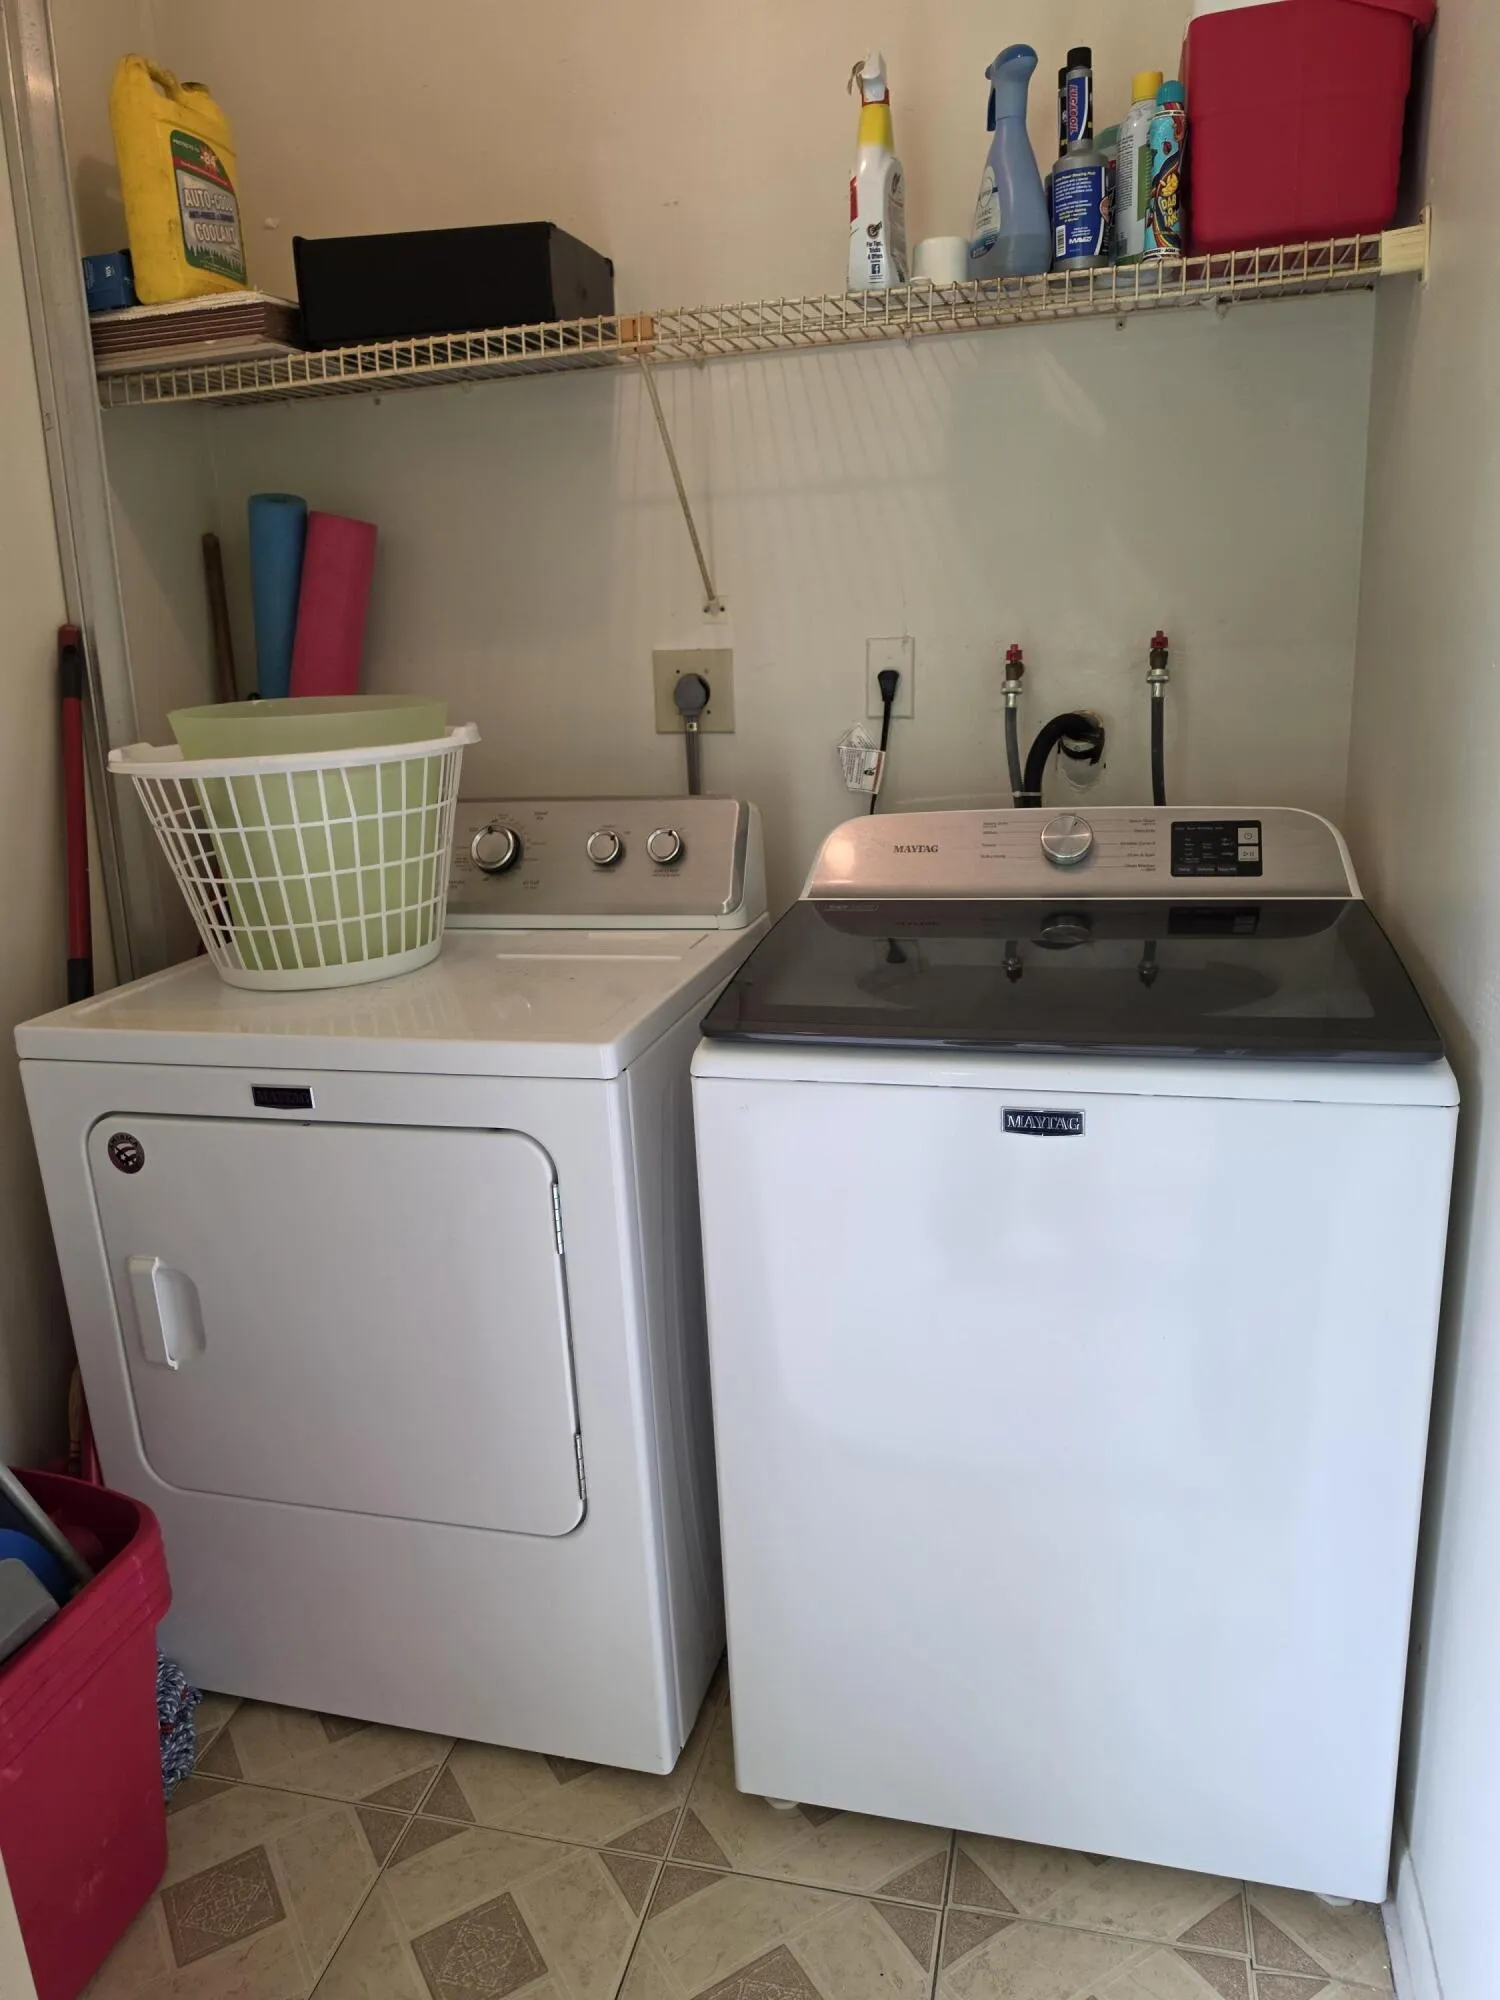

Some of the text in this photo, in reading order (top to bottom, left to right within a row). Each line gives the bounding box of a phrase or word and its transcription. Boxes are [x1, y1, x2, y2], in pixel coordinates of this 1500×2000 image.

[195, 223, 235, 243] COOLANT
[893, 844, 939, 854] MAYTAG
[1006, 1113, 1081, 1131] MAYTAG
